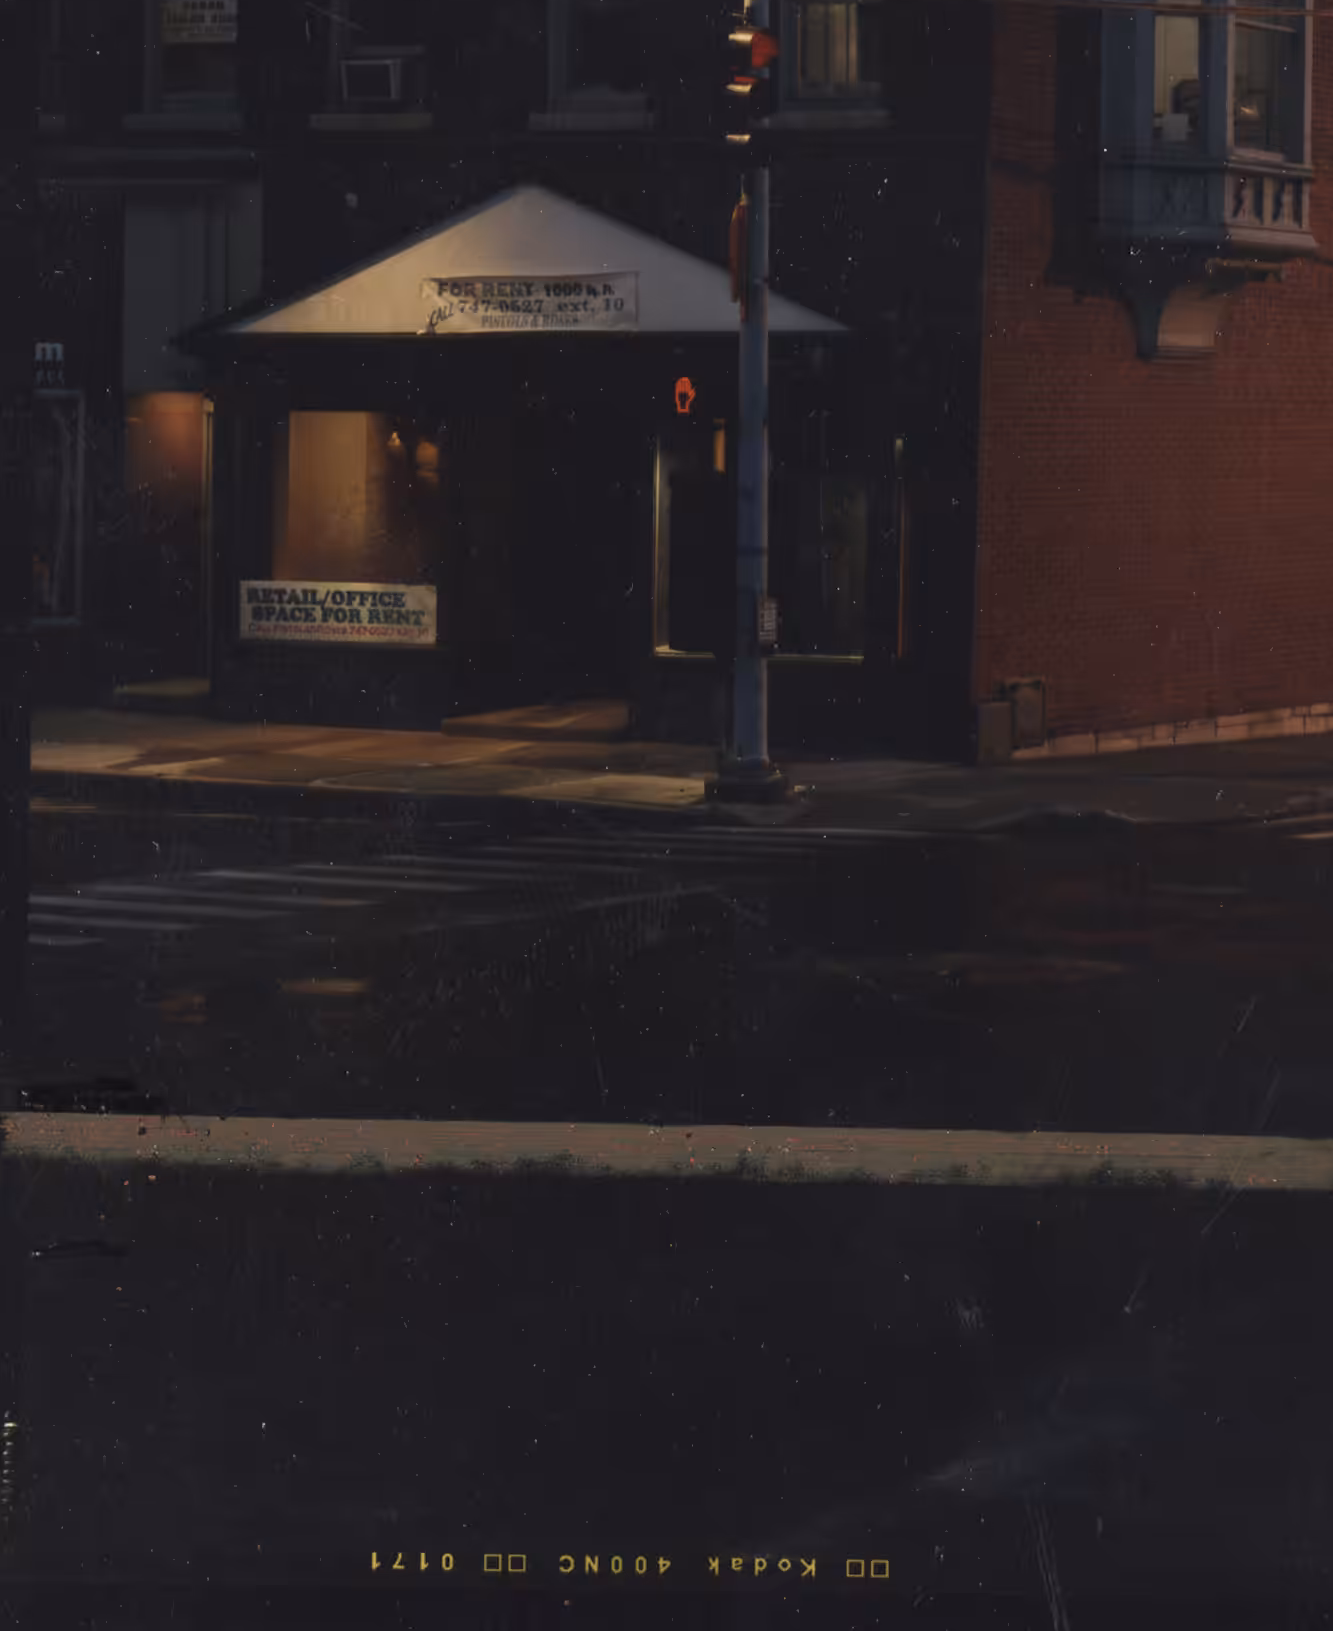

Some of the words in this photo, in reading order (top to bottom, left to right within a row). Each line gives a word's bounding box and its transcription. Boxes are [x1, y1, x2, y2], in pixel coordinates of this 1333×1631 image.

[437, 282, 477, 298] FOR
[247, 588, 406, 609] RETAIL/OFFICE
[252, 606, 316, 623] SPACE
[321, 607, 362, 625] FOR
[367, 609, 426, 626] RENT
[372, 1553, 453, 1571] 0171
[560, 1555, 671, 1574] 400NC
[710, 1558, 815, 1576] Kodak
